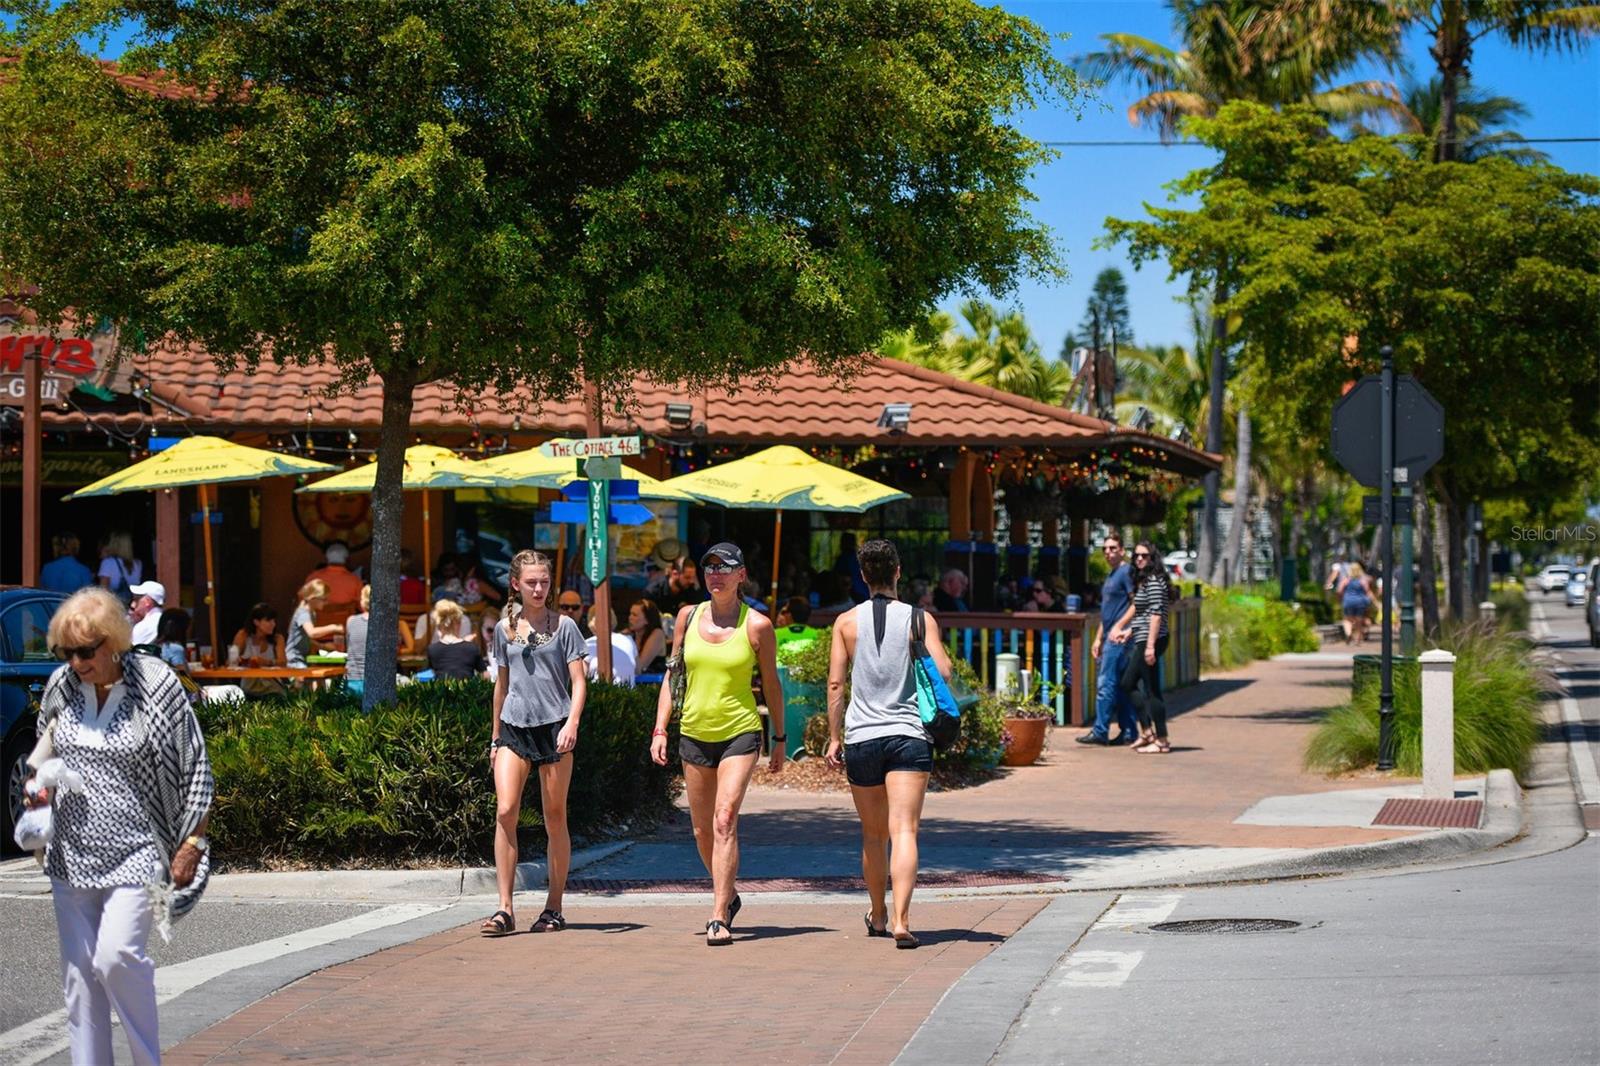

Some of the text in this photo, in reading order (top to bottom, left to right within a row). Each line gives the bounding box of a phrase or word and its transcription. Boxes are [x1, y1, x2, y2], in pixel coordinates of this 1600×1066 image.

[550, 443, 571, 456] THE
[618, 439, 632, 454] 46
[155, 464, 228, 475] LANDSHARK
[592, 481, 603, 510] YOU
[588, 538, 602, 581] HERE
